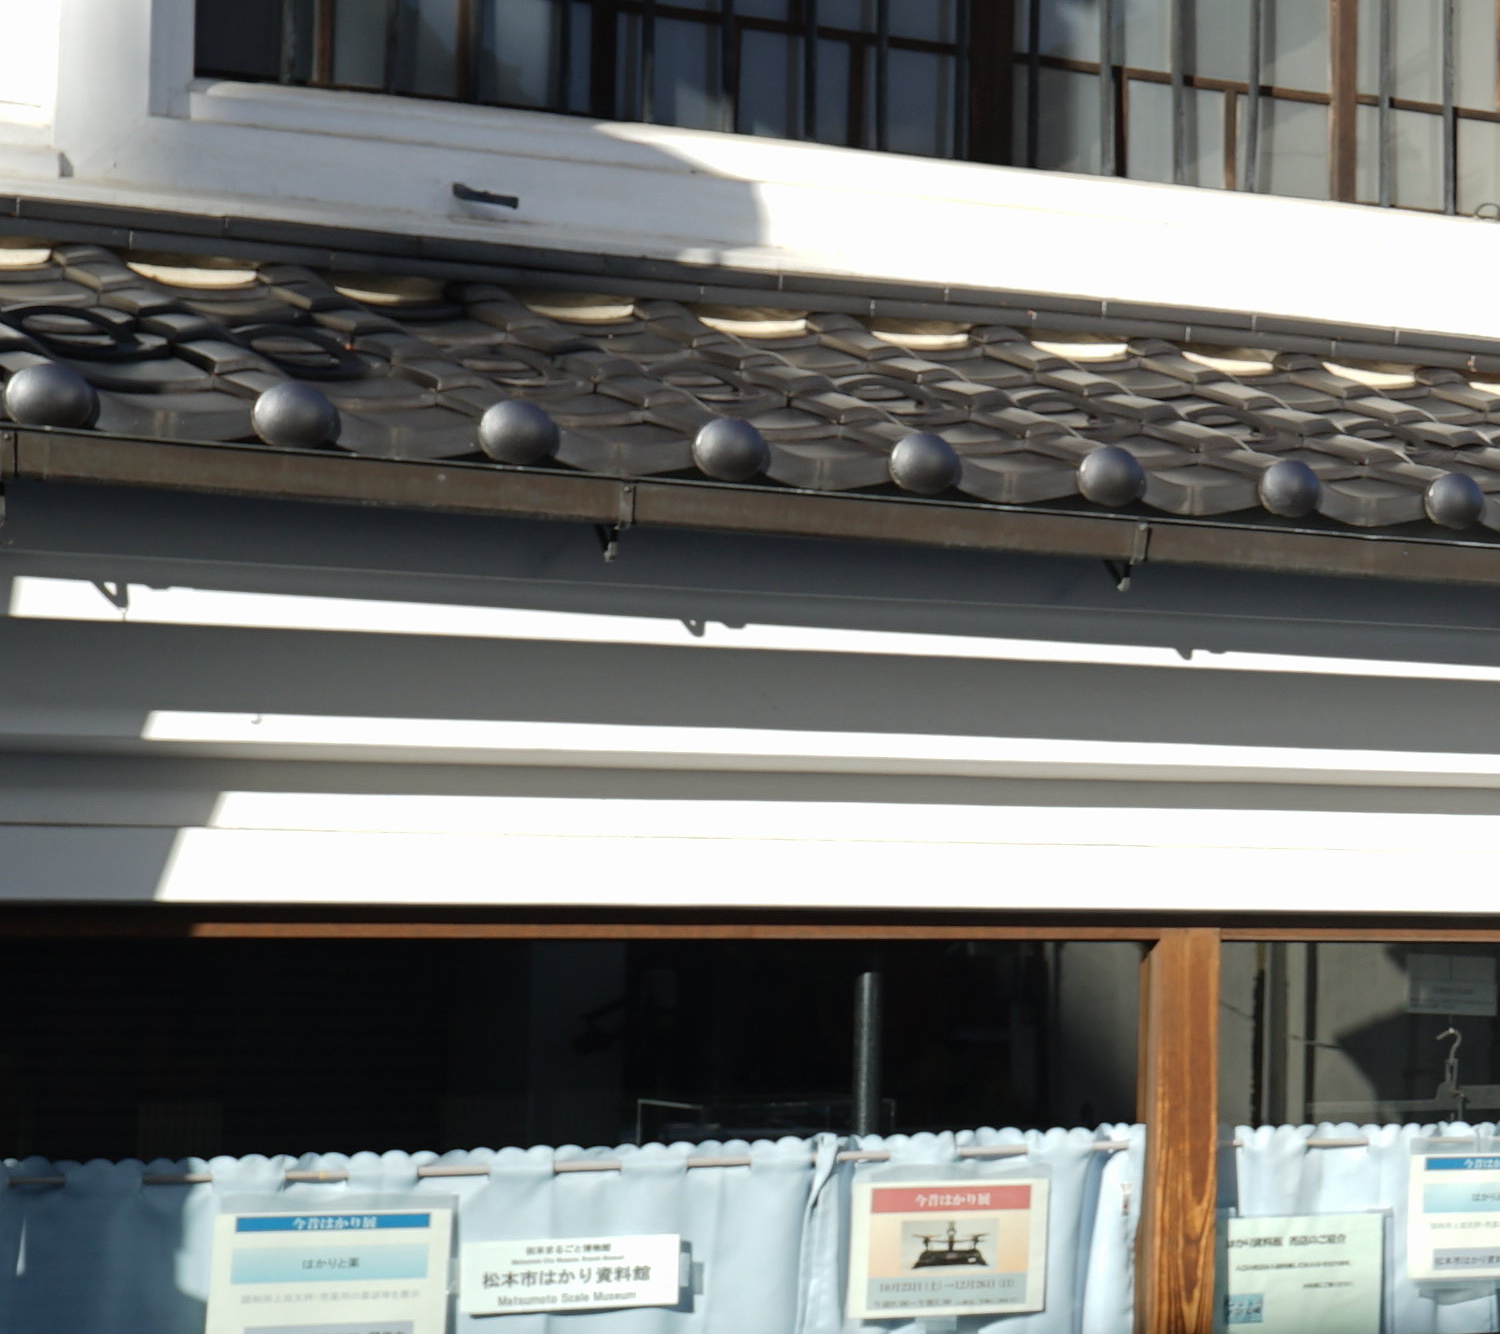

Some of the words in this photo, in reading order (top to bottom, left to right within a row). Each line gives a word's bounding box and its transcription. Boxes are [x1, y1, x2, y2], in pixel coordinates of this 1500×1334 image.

[915, 1193, 992, 1207] 今昔はかり展
[293, 1217, 377, 1230] 今昔はかり展
[483, 1266, 650, 1289] 松本市はかり資料館
[498, 1294, 557, 1307] Matsumoto
[561, 1292, 589, 1303] Scale
[593, 1291, 636, 1301] Museum
